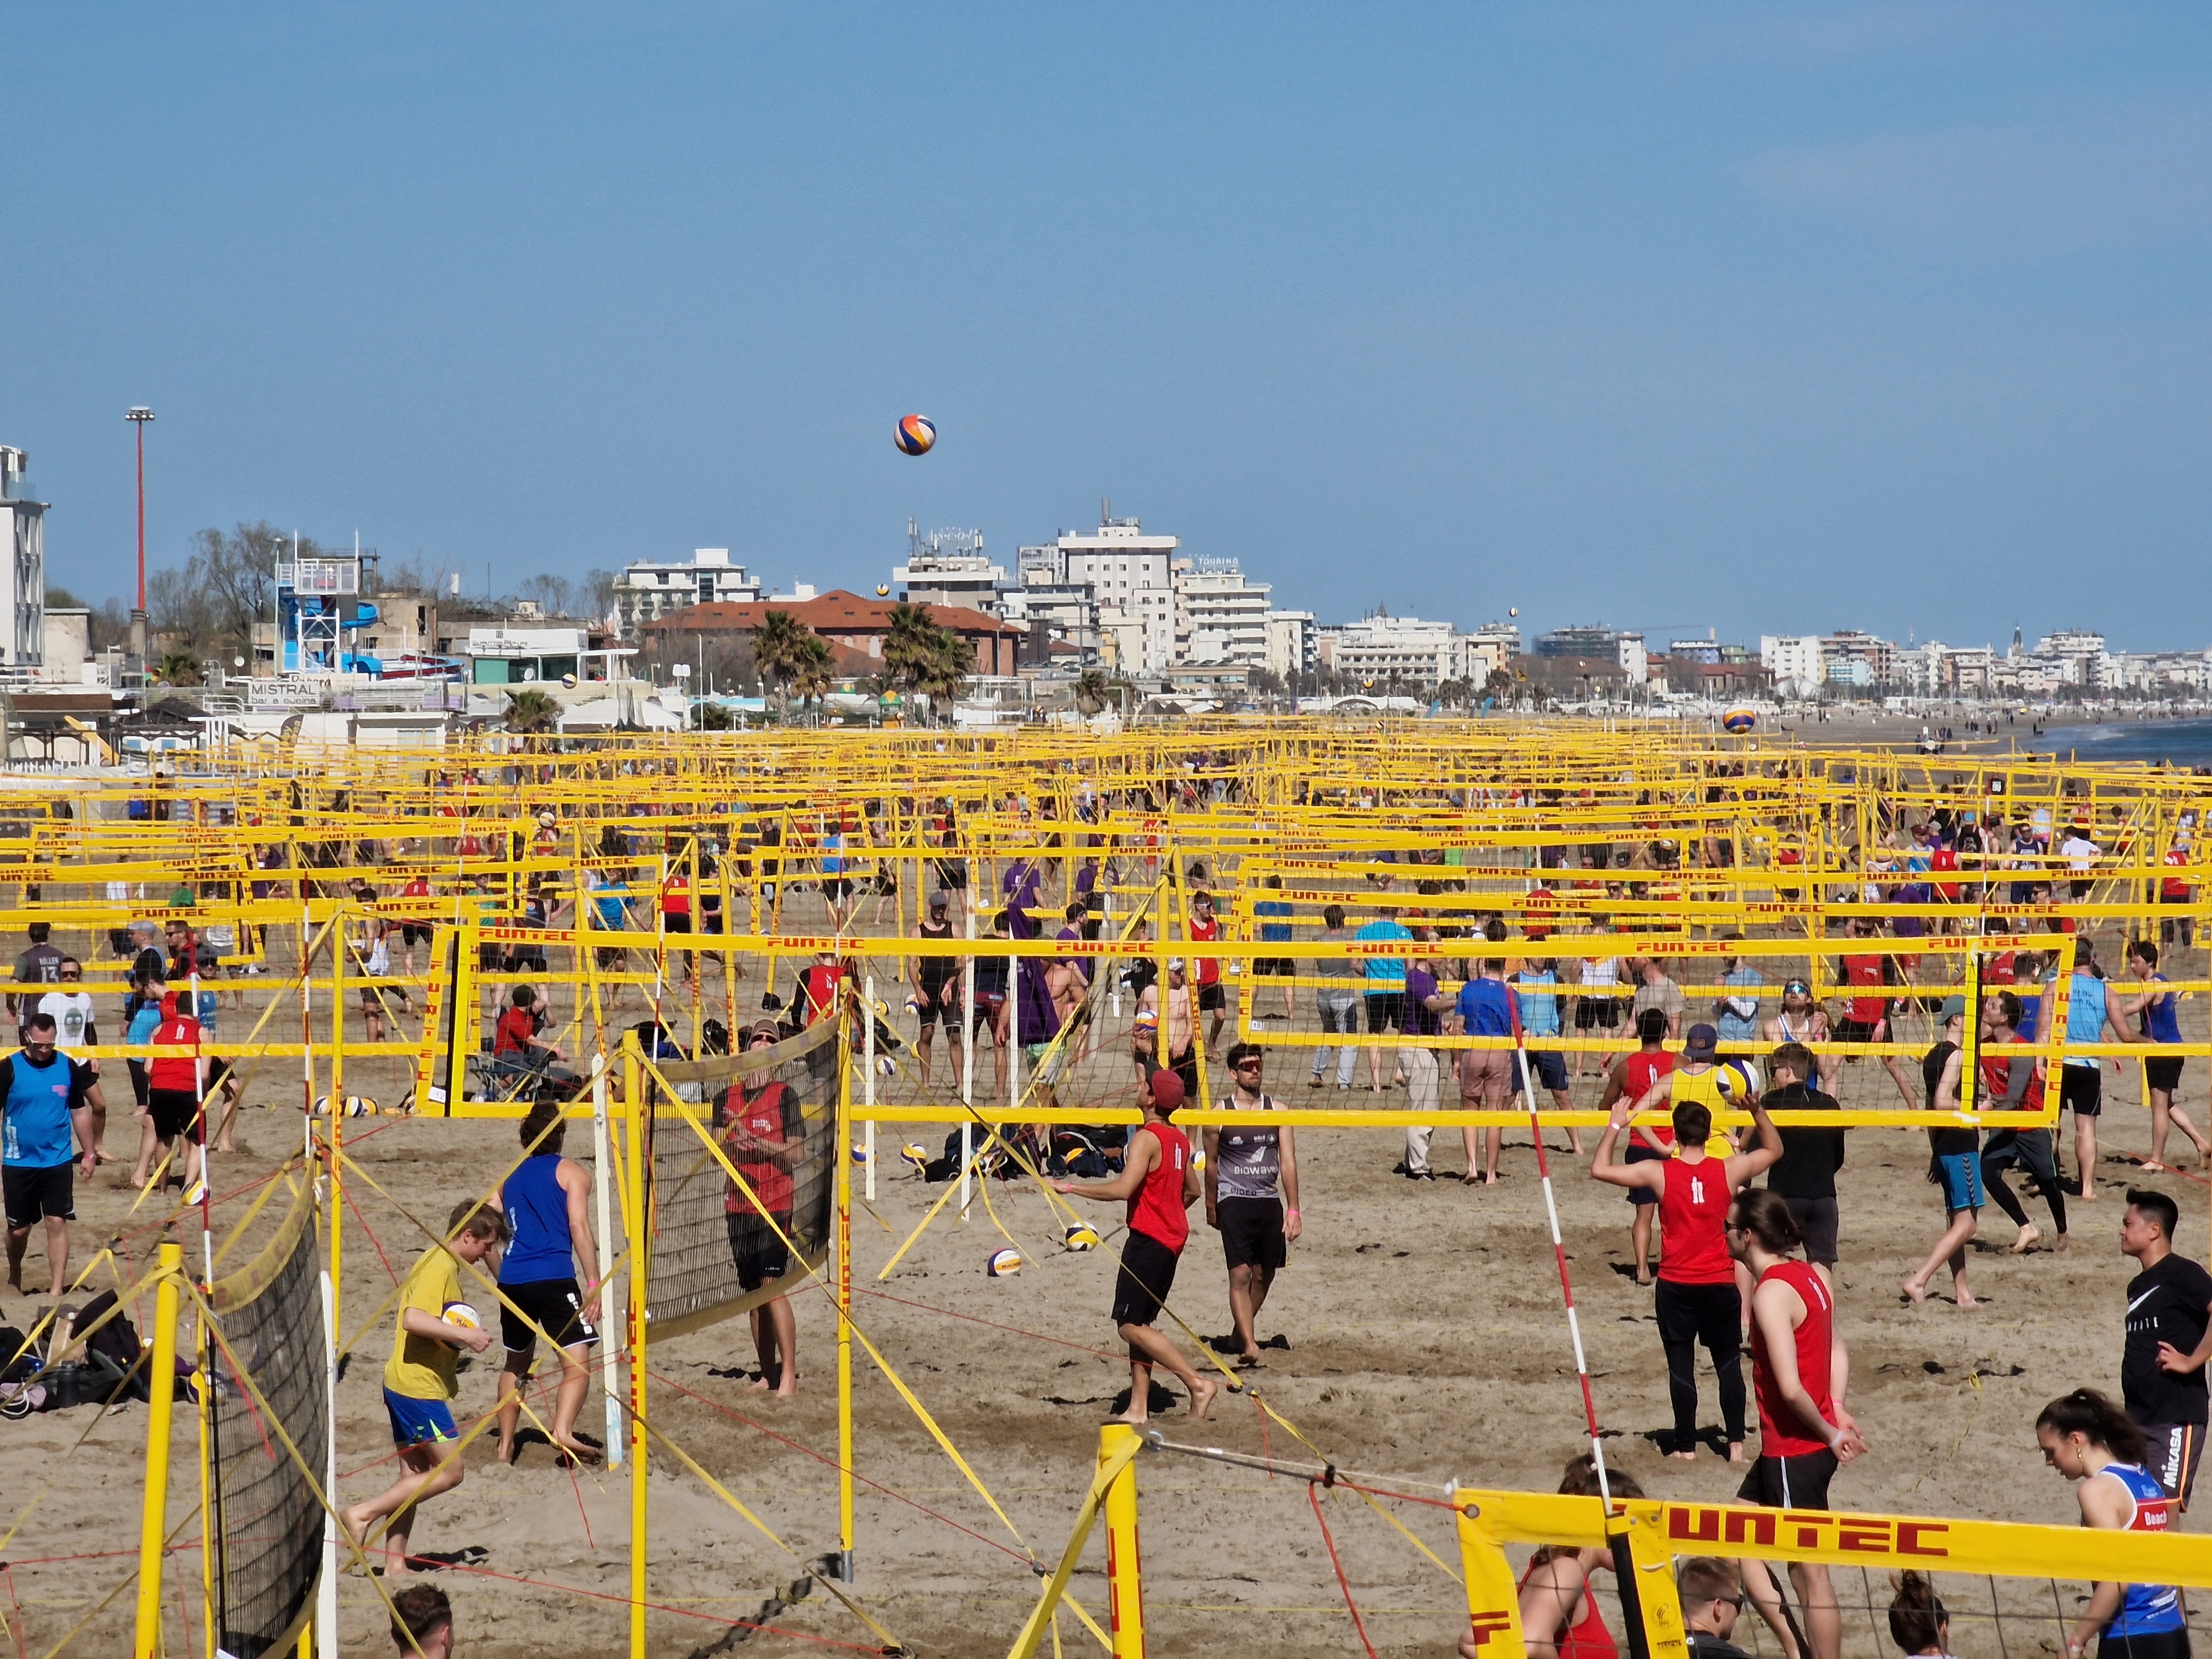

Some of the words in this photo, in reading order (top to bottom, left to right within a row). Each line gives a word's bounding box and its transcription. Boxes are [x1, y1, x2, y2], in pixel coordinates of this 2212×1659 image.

[252, 684, 317, 695] MISTRAL
[1274, 860, 1339, 869] FUNTEC
[1279, 891, 1358, 902] FUNTEC
[363, 902, 441, 911] FUNTEC
[1513, 899, 1592, 908] FUNTEC
[132, 909, 211, 917] FUNTEC
[479, 927, 576, 942] FUNTEC
[768, 937, 864, 948] FUNTEC
[1057, 942, 1154, 953] FUNTEC
[1636, 942, 1734, 952] FUNTEC
[1346, 943, 1444, 953] FUNTEC
[1612, 1507, 1949, 1556] UNTEC
